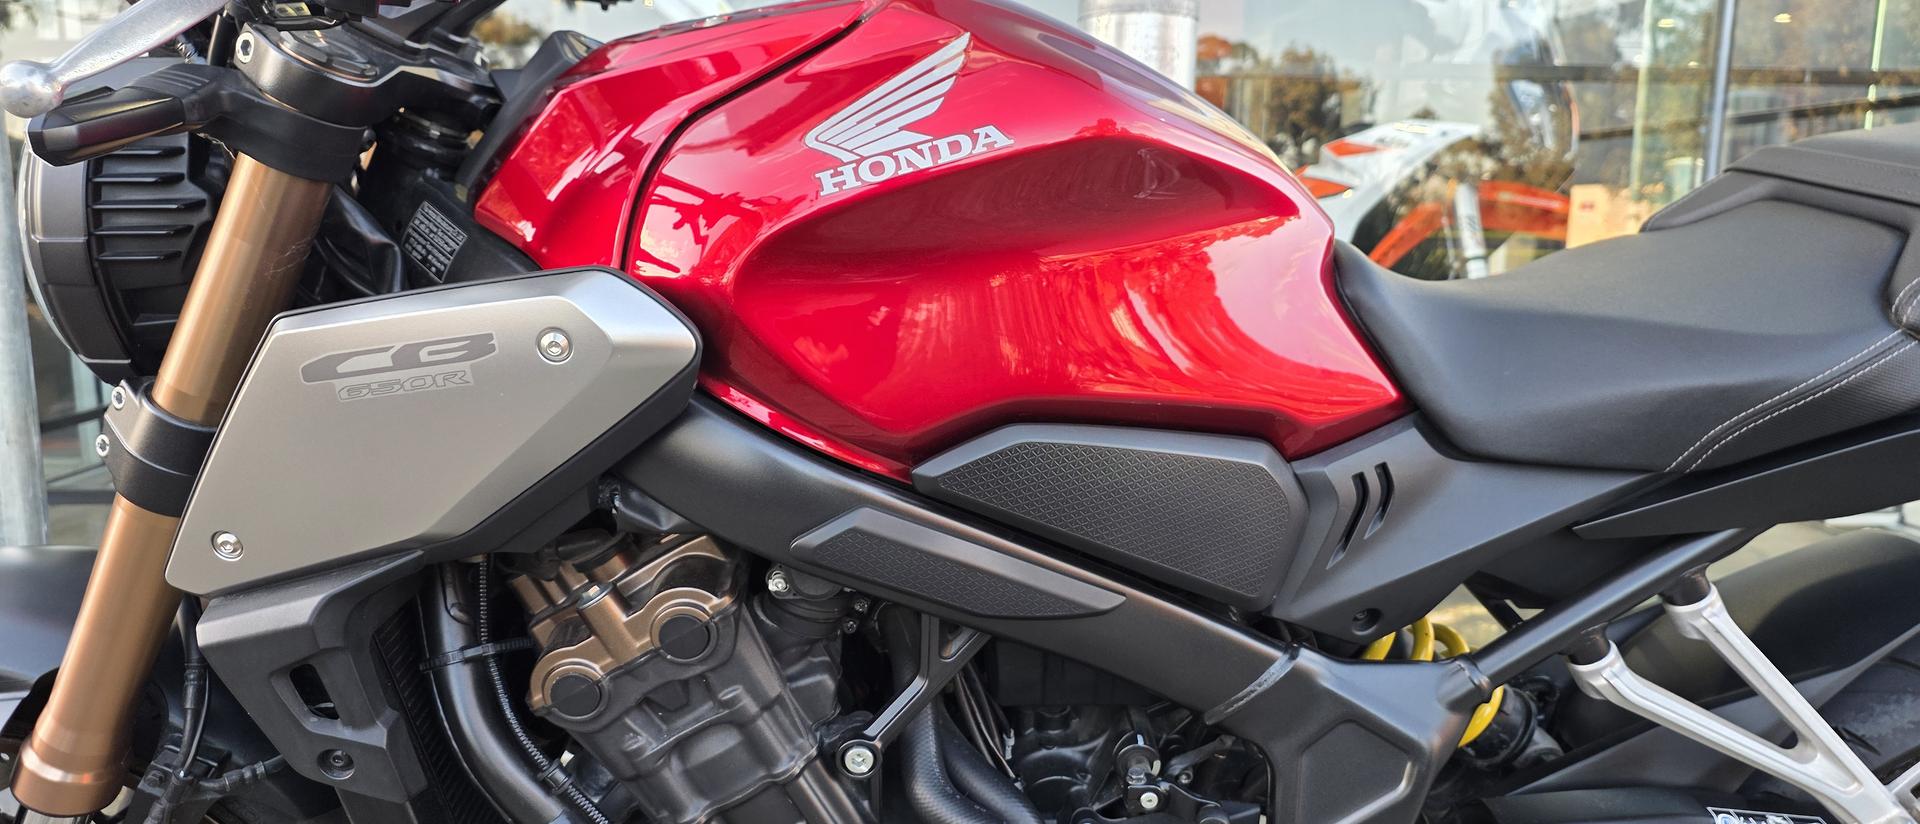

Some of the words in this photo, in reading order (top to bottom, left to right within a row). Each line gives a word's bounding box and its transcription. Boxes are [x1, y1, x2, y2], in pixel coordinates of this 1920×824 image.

[815, 125, 1015, 197] HONDA
[301, 332, 496, 383] CB
[338, 370, 471, 401] 650R
